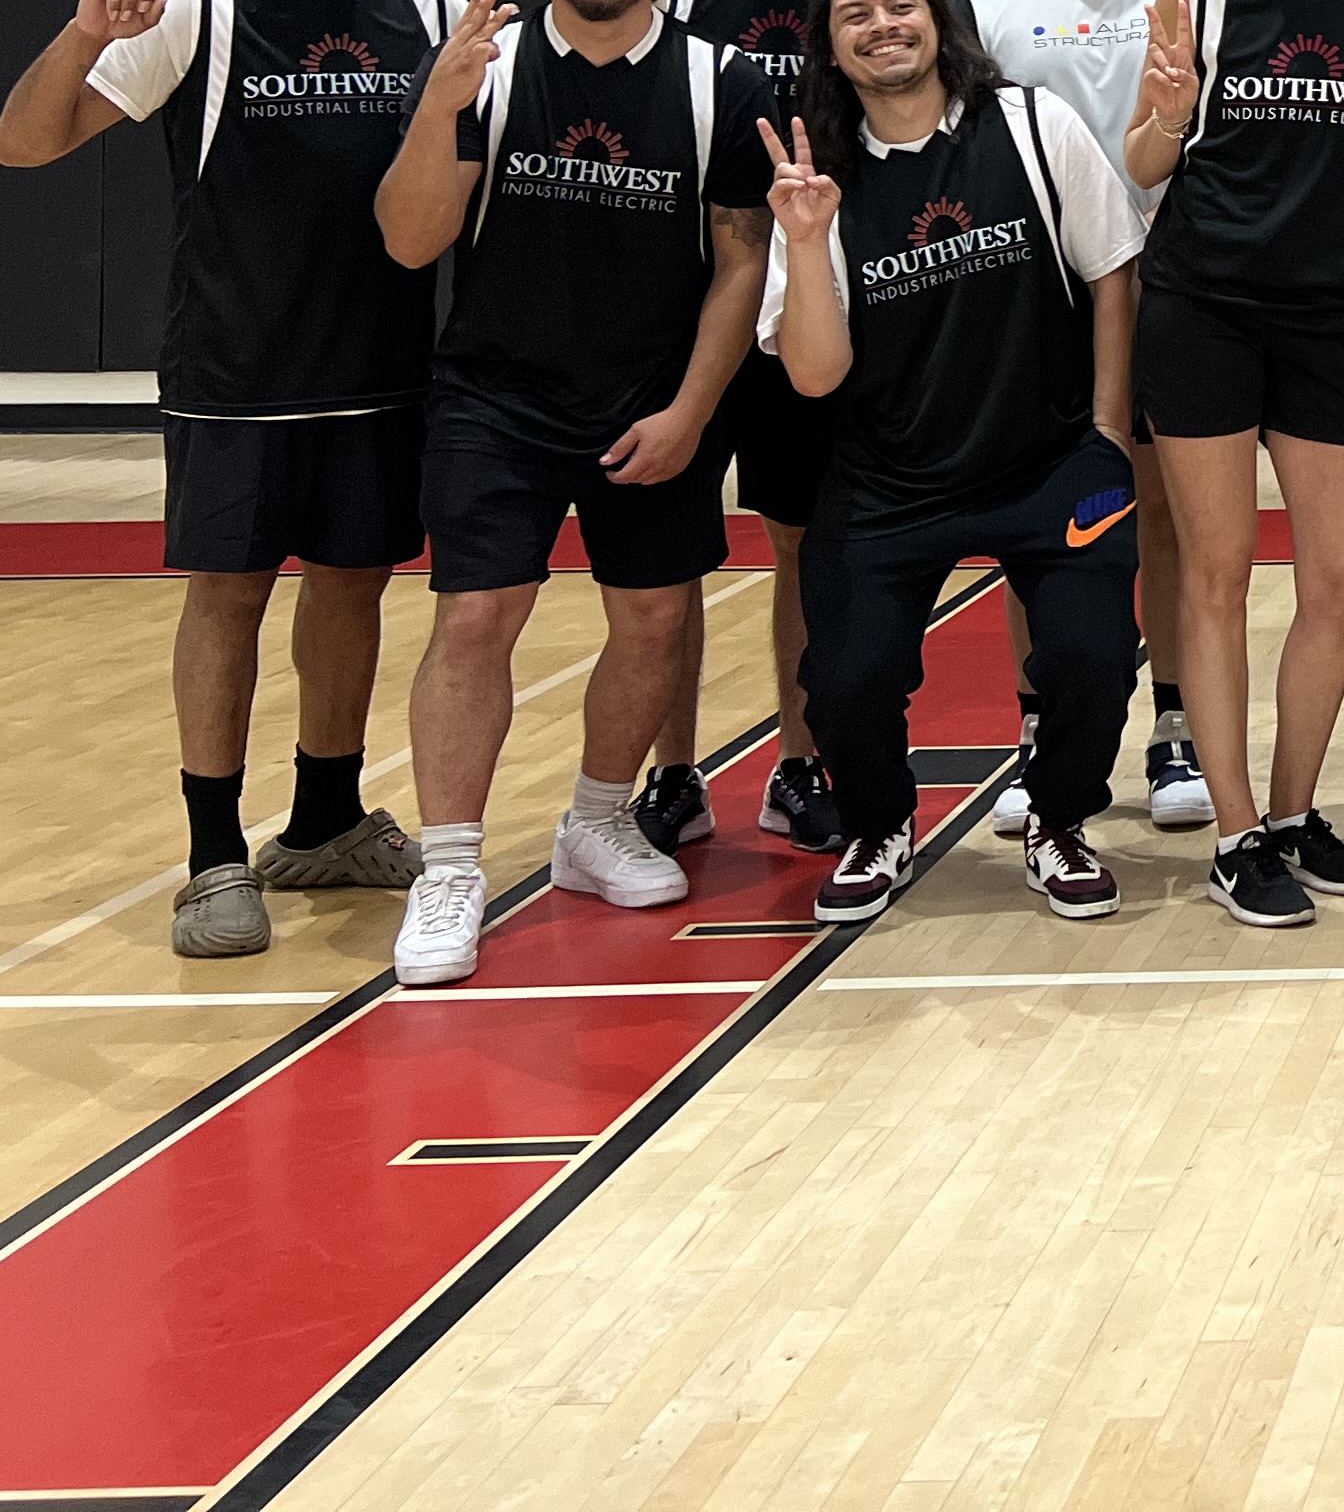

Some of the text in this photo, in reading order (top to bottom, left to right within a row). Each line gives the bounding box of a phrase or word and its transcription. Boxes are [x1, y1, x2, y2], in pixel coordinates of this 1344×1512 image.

[242, 73, 415, 99] SOUTHWES
[244, 102, 350, 119] INDUSTRIAL
[1222, 107, 1322, 123] INDUSTRIAL
[506, 151, 682, 194] SOUTHWEST
[501, 181, 677, 213] INDUSTRIAL ELECTRIC
[862, 217, 1027, 285] SOUTHWEST
